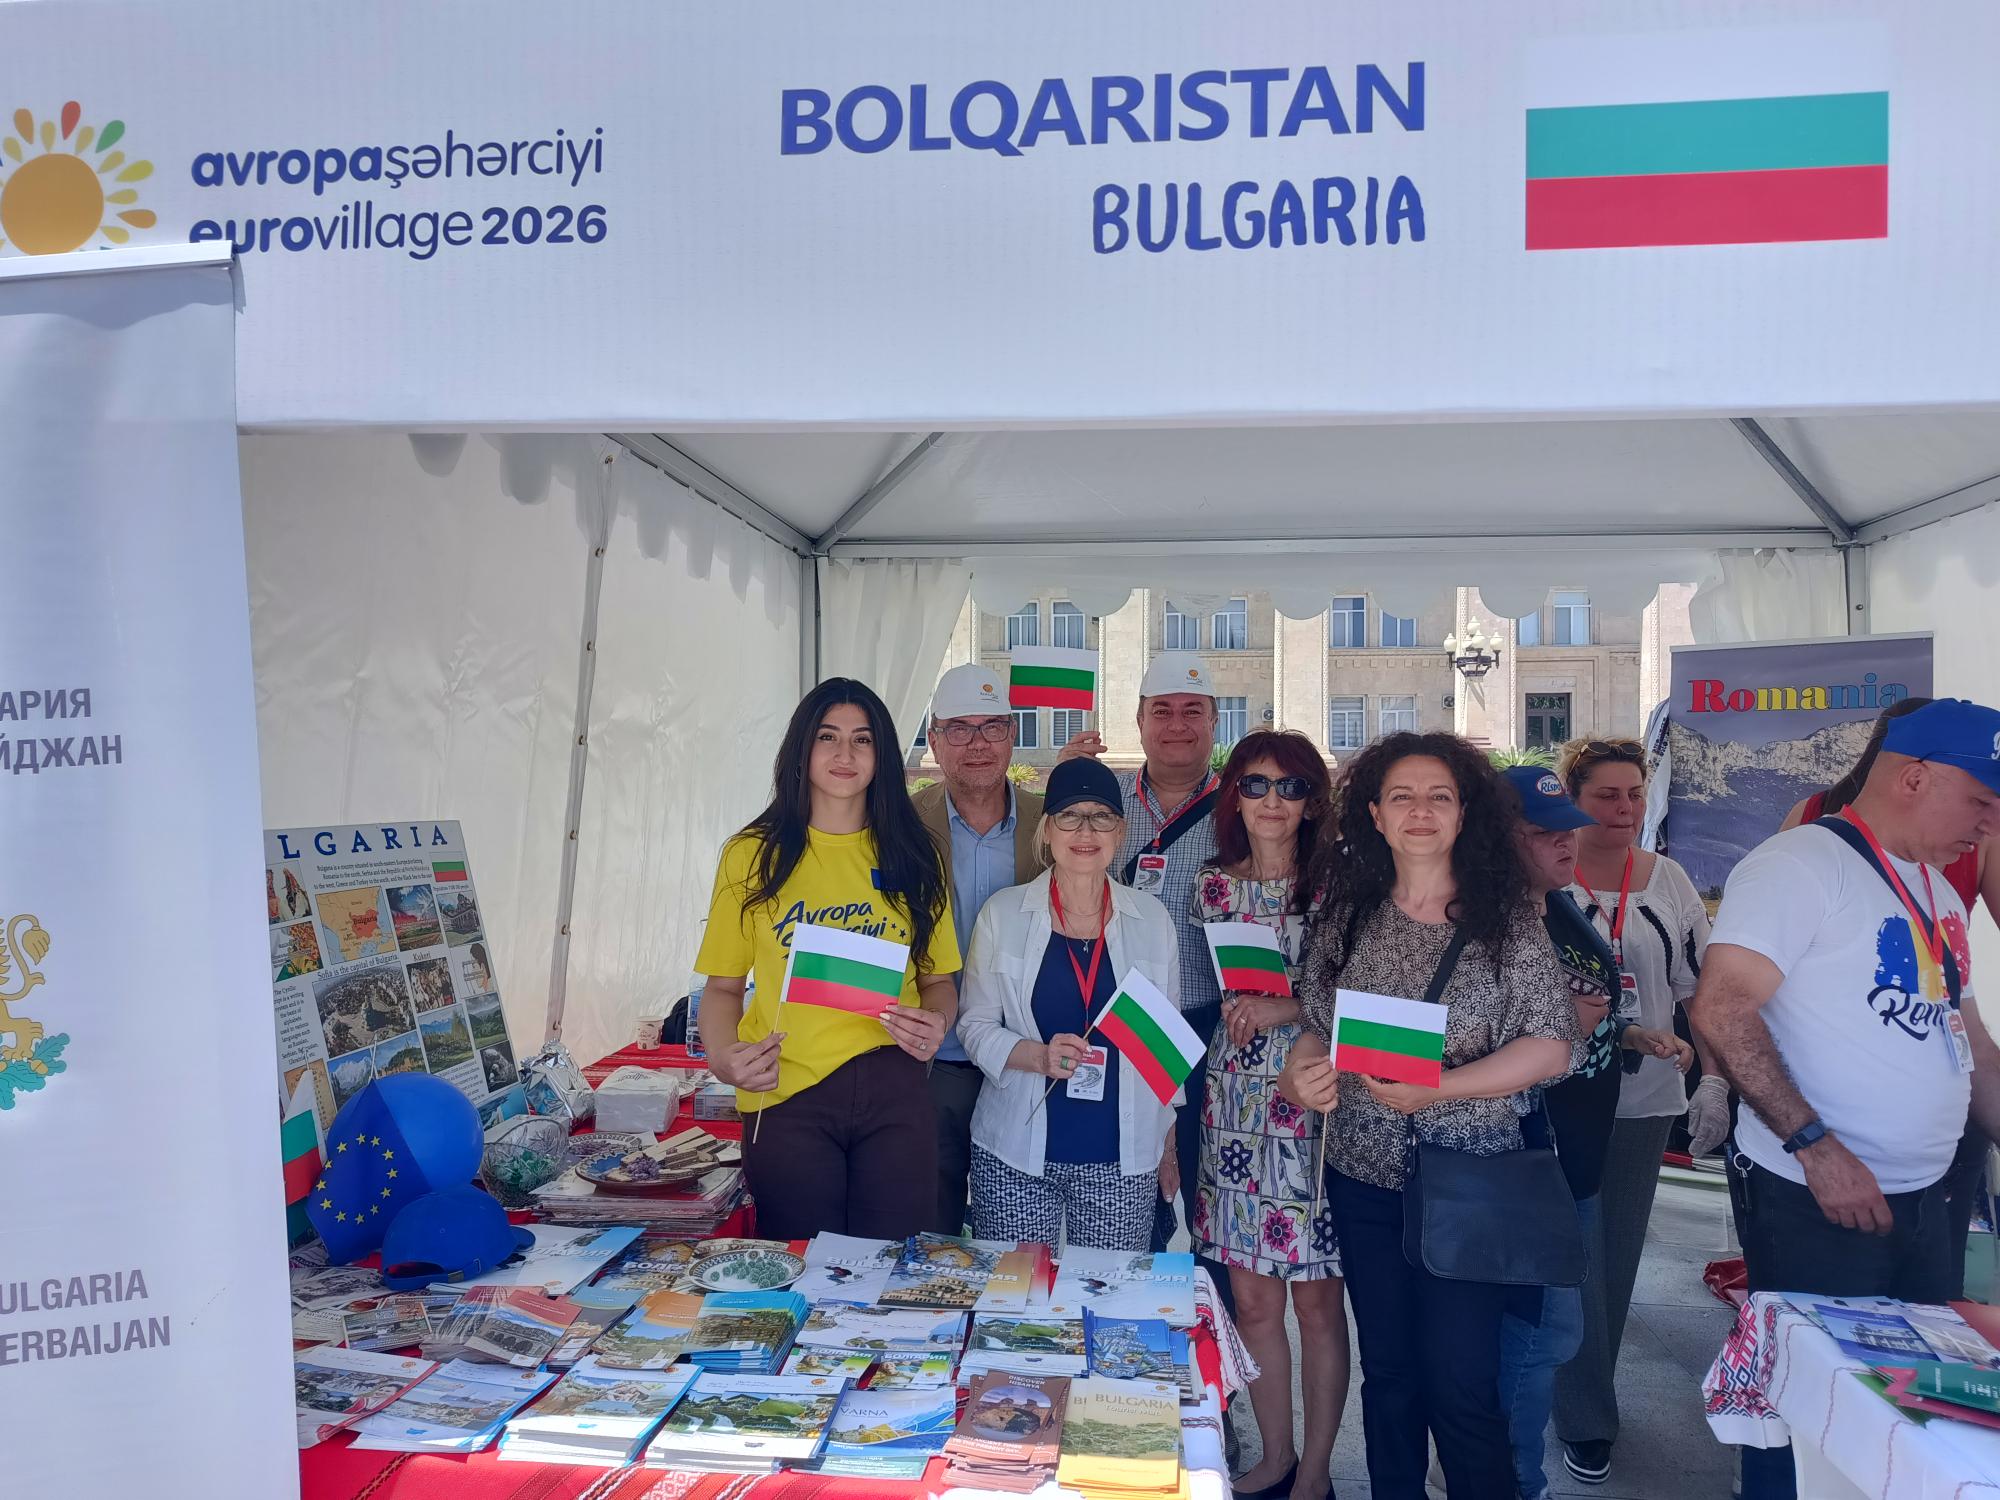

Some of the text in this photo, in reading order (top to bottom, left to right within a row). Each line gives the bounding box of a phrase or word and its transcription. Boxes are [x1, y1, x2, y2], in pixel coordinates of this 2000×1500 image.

[781, 62, 1425, 157] BOLQARISTAN
[192, 127, 603, 195] avropaşəhərciyi
[1092, 175, 1425, 254] BULGARIA
[0, 688, 92, 722] АРИЯ
[1687, 672, 1908, 713] Romania
[772, 900, 874, 942] Avropa
[0, 1269, 149, 1315] ULGARIA
[0, 1315, 171, 1366] ERBAIJAN
[840, 1407, 888, 1416] VARNA
[1095, 1393, 1174, 1410] BULGARIA
